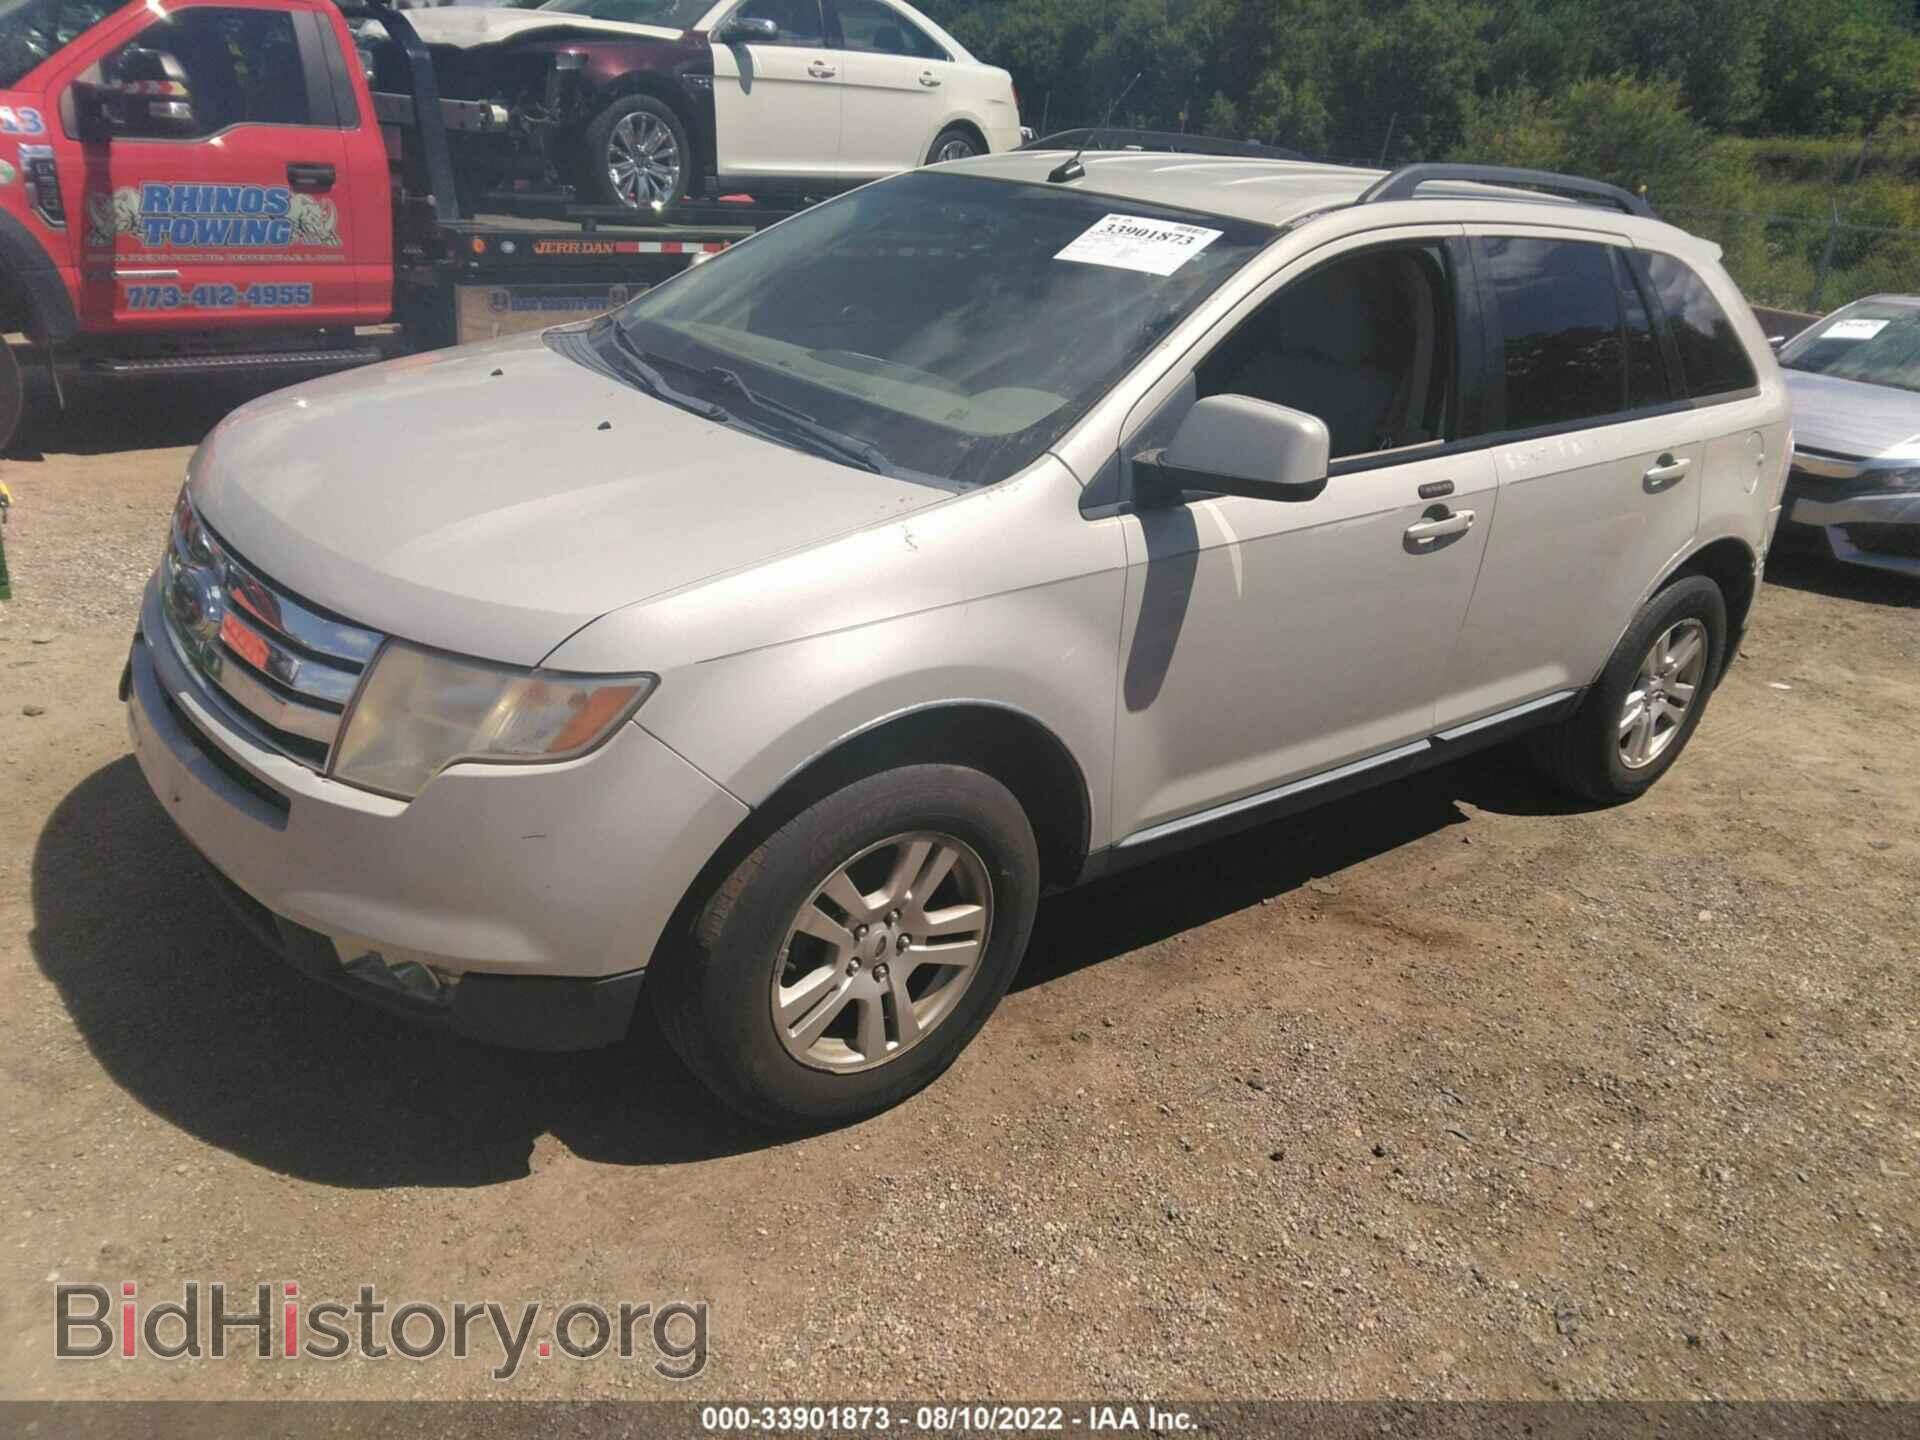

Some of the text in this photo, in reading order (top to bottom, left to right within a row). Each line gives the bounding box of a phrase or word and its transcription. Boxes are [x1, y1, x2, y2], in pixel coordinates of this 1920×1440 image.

[141, 183, 289, 215] RHINOS
[141, 217, 292, 247] TOWING
[1099, 222, 1196, 246] 33901873
[126, 283, 313, 309] 773-412-4955
